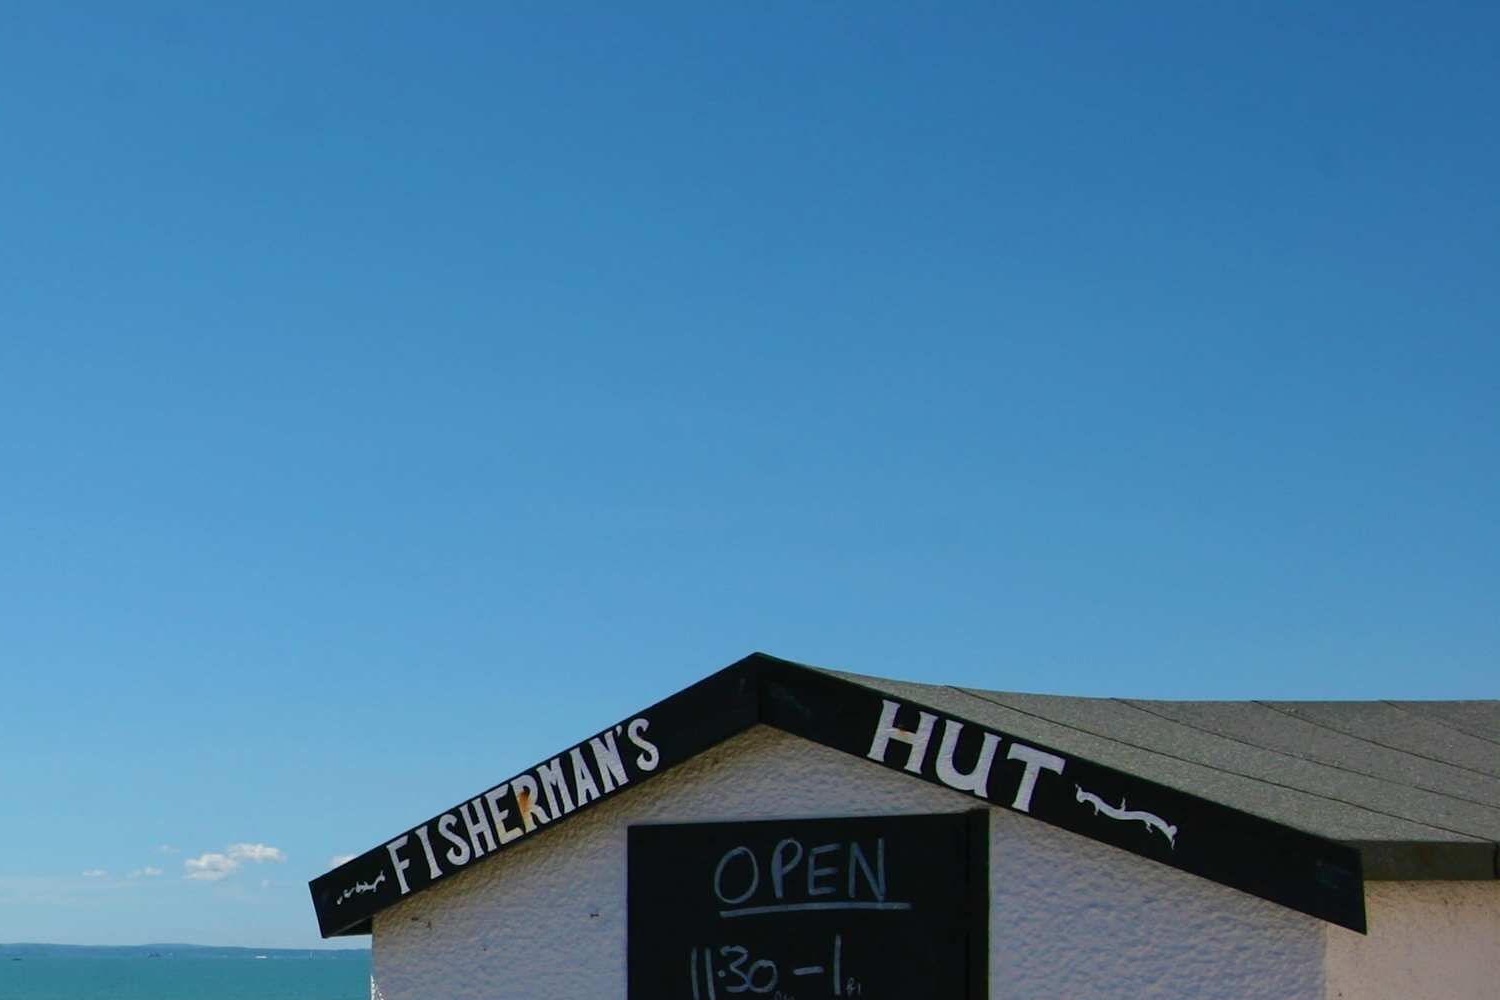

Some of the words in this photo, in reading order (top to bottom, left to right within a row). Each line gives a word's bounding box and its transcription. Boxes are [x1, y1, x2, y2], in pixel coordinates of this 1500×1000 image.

[386, 718, 660, 895] FISHERMAN'S
[867, 699, 1067, 813] HUT
[713, 838, 887, 905] OPEN
